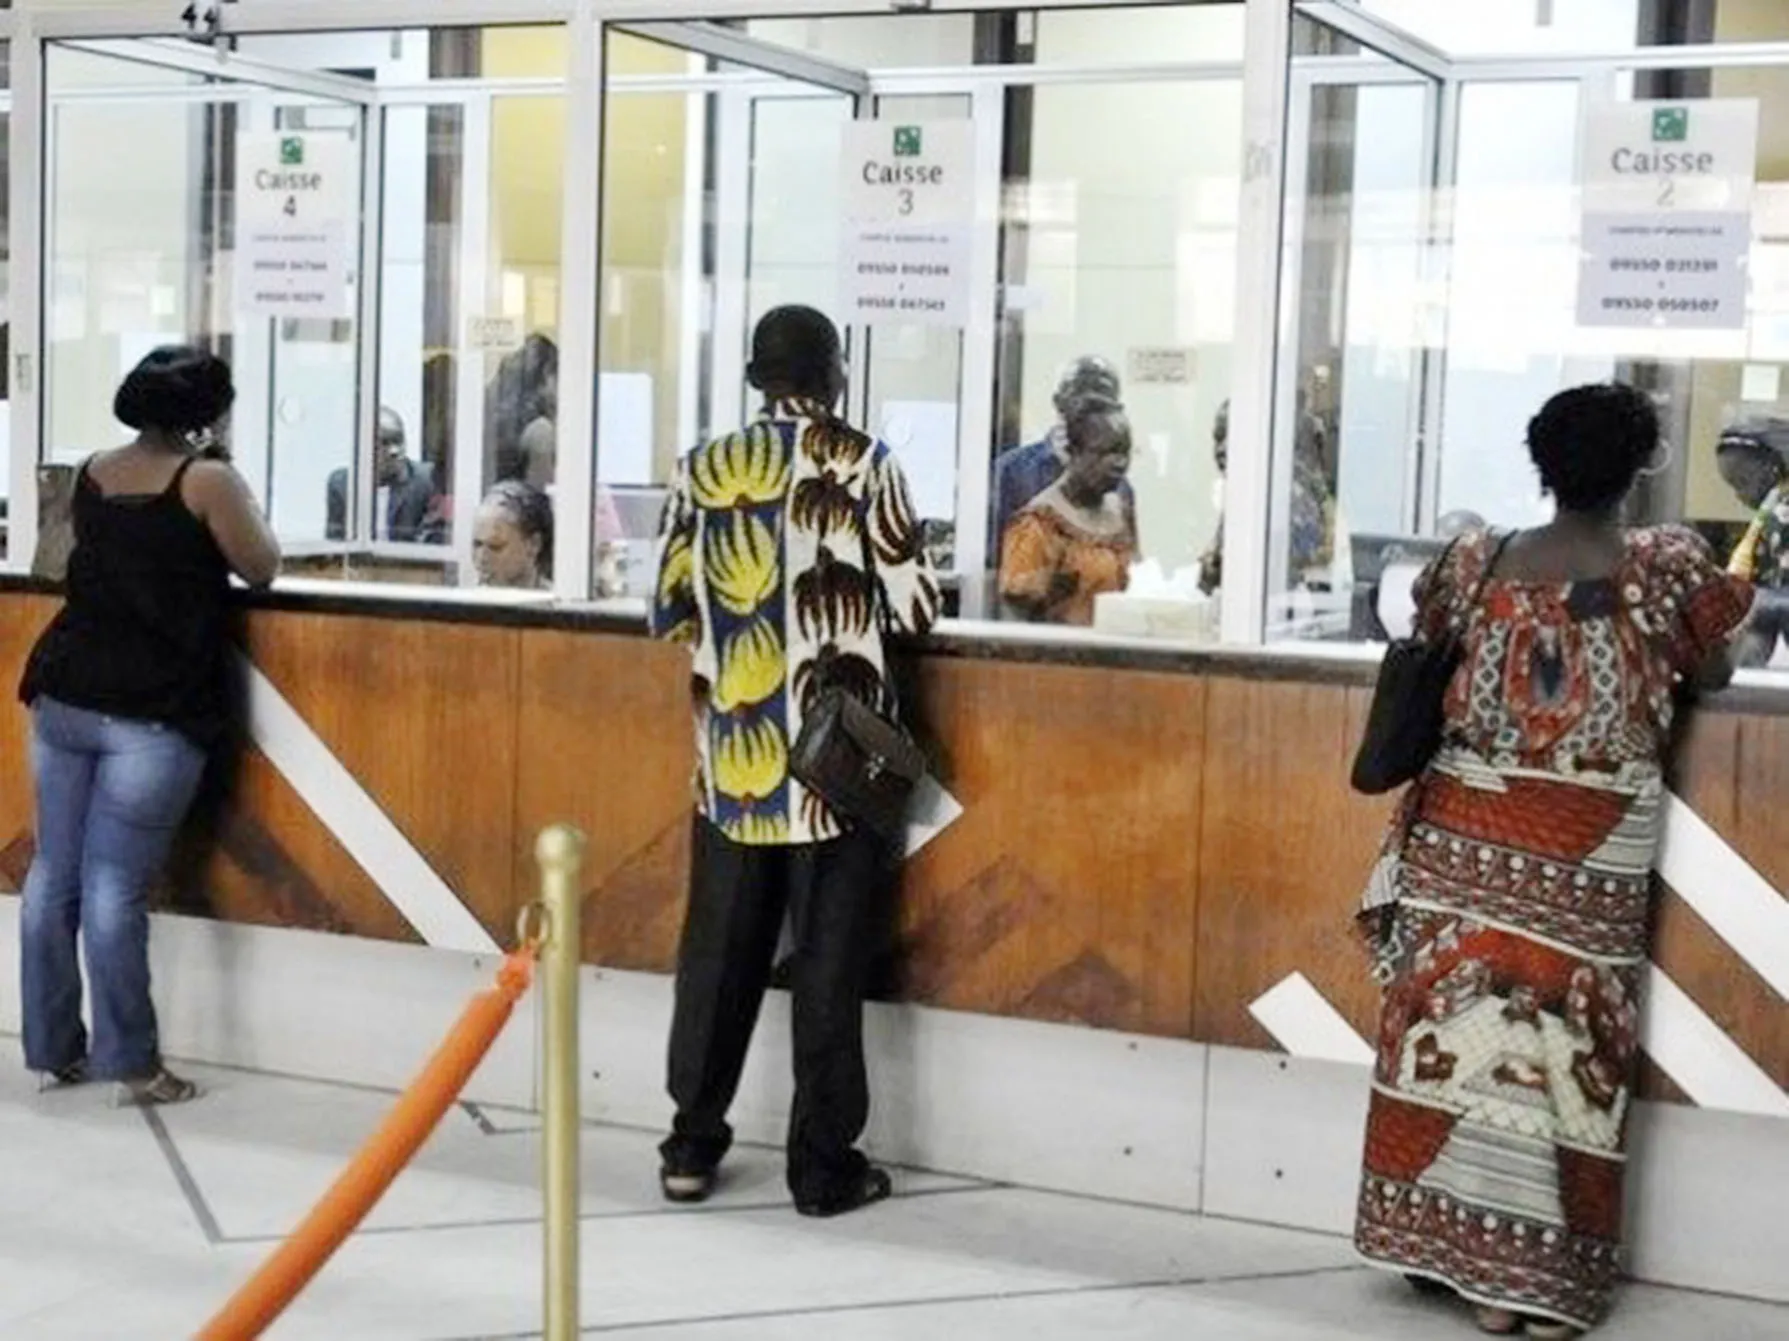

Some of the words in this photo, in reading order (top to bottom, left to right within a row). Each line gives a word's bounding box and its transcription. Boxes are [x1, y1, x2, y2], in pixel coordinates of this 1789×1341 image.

[861, 161, 944, 184] Caisse
[1611, 147, 1714, 174] Caisse
[255, 168, 322, 191] Caisse
[283, 195, 297, 217] 4
[897, 188, 915, 215] 3
[1655, 180, 1676, 207] 2
